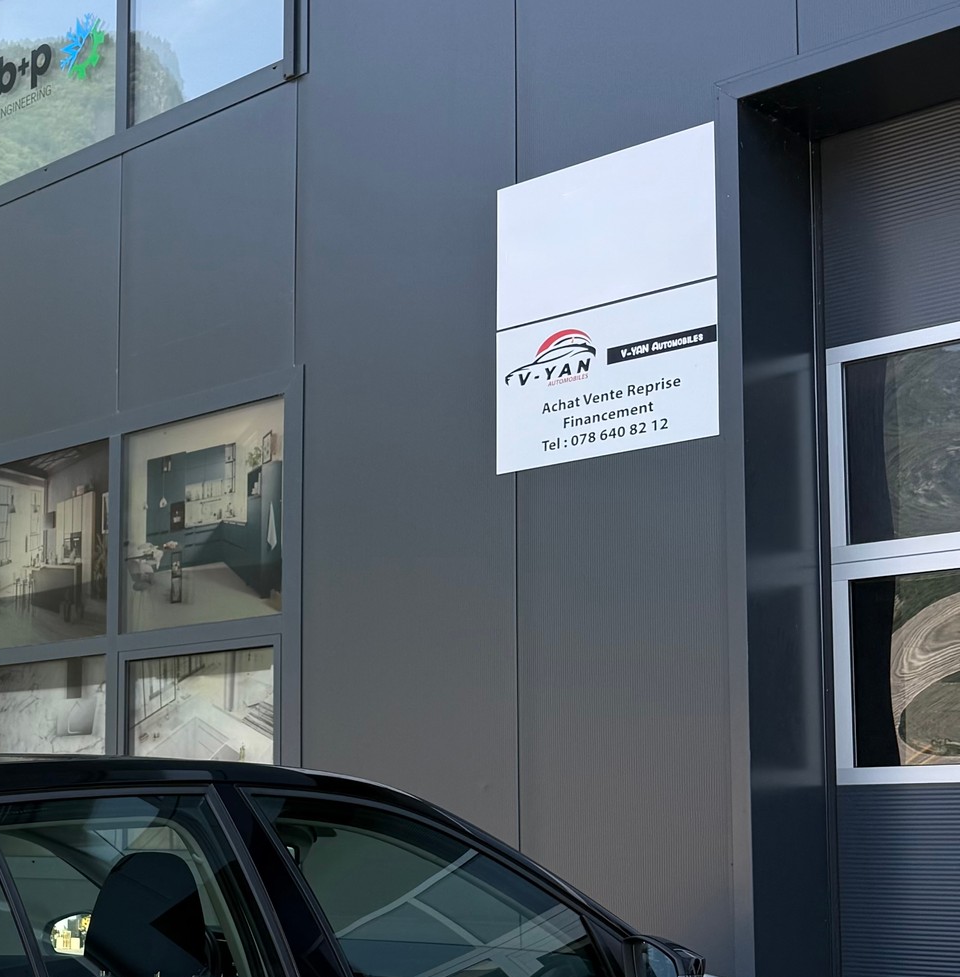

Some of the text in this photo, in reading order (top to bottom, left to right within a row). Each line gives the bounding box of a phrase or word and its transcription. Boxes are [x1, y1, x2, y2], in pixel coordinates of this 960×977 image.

[620, 343, 650, 358] V-YAN
[518, 358, 591, 386] V-YAN
[547, 373, 589, 387] AUTOMOBILES
[541, 377, 682, 415] Achat Vente Reprise
[562, 401, 654, 429] Financement
[570, 431, 596, 447] 078
[599, 426, 626, 441] 640
[629, 421, 647, 436] 82
[650, 418, 669, 432] 12
